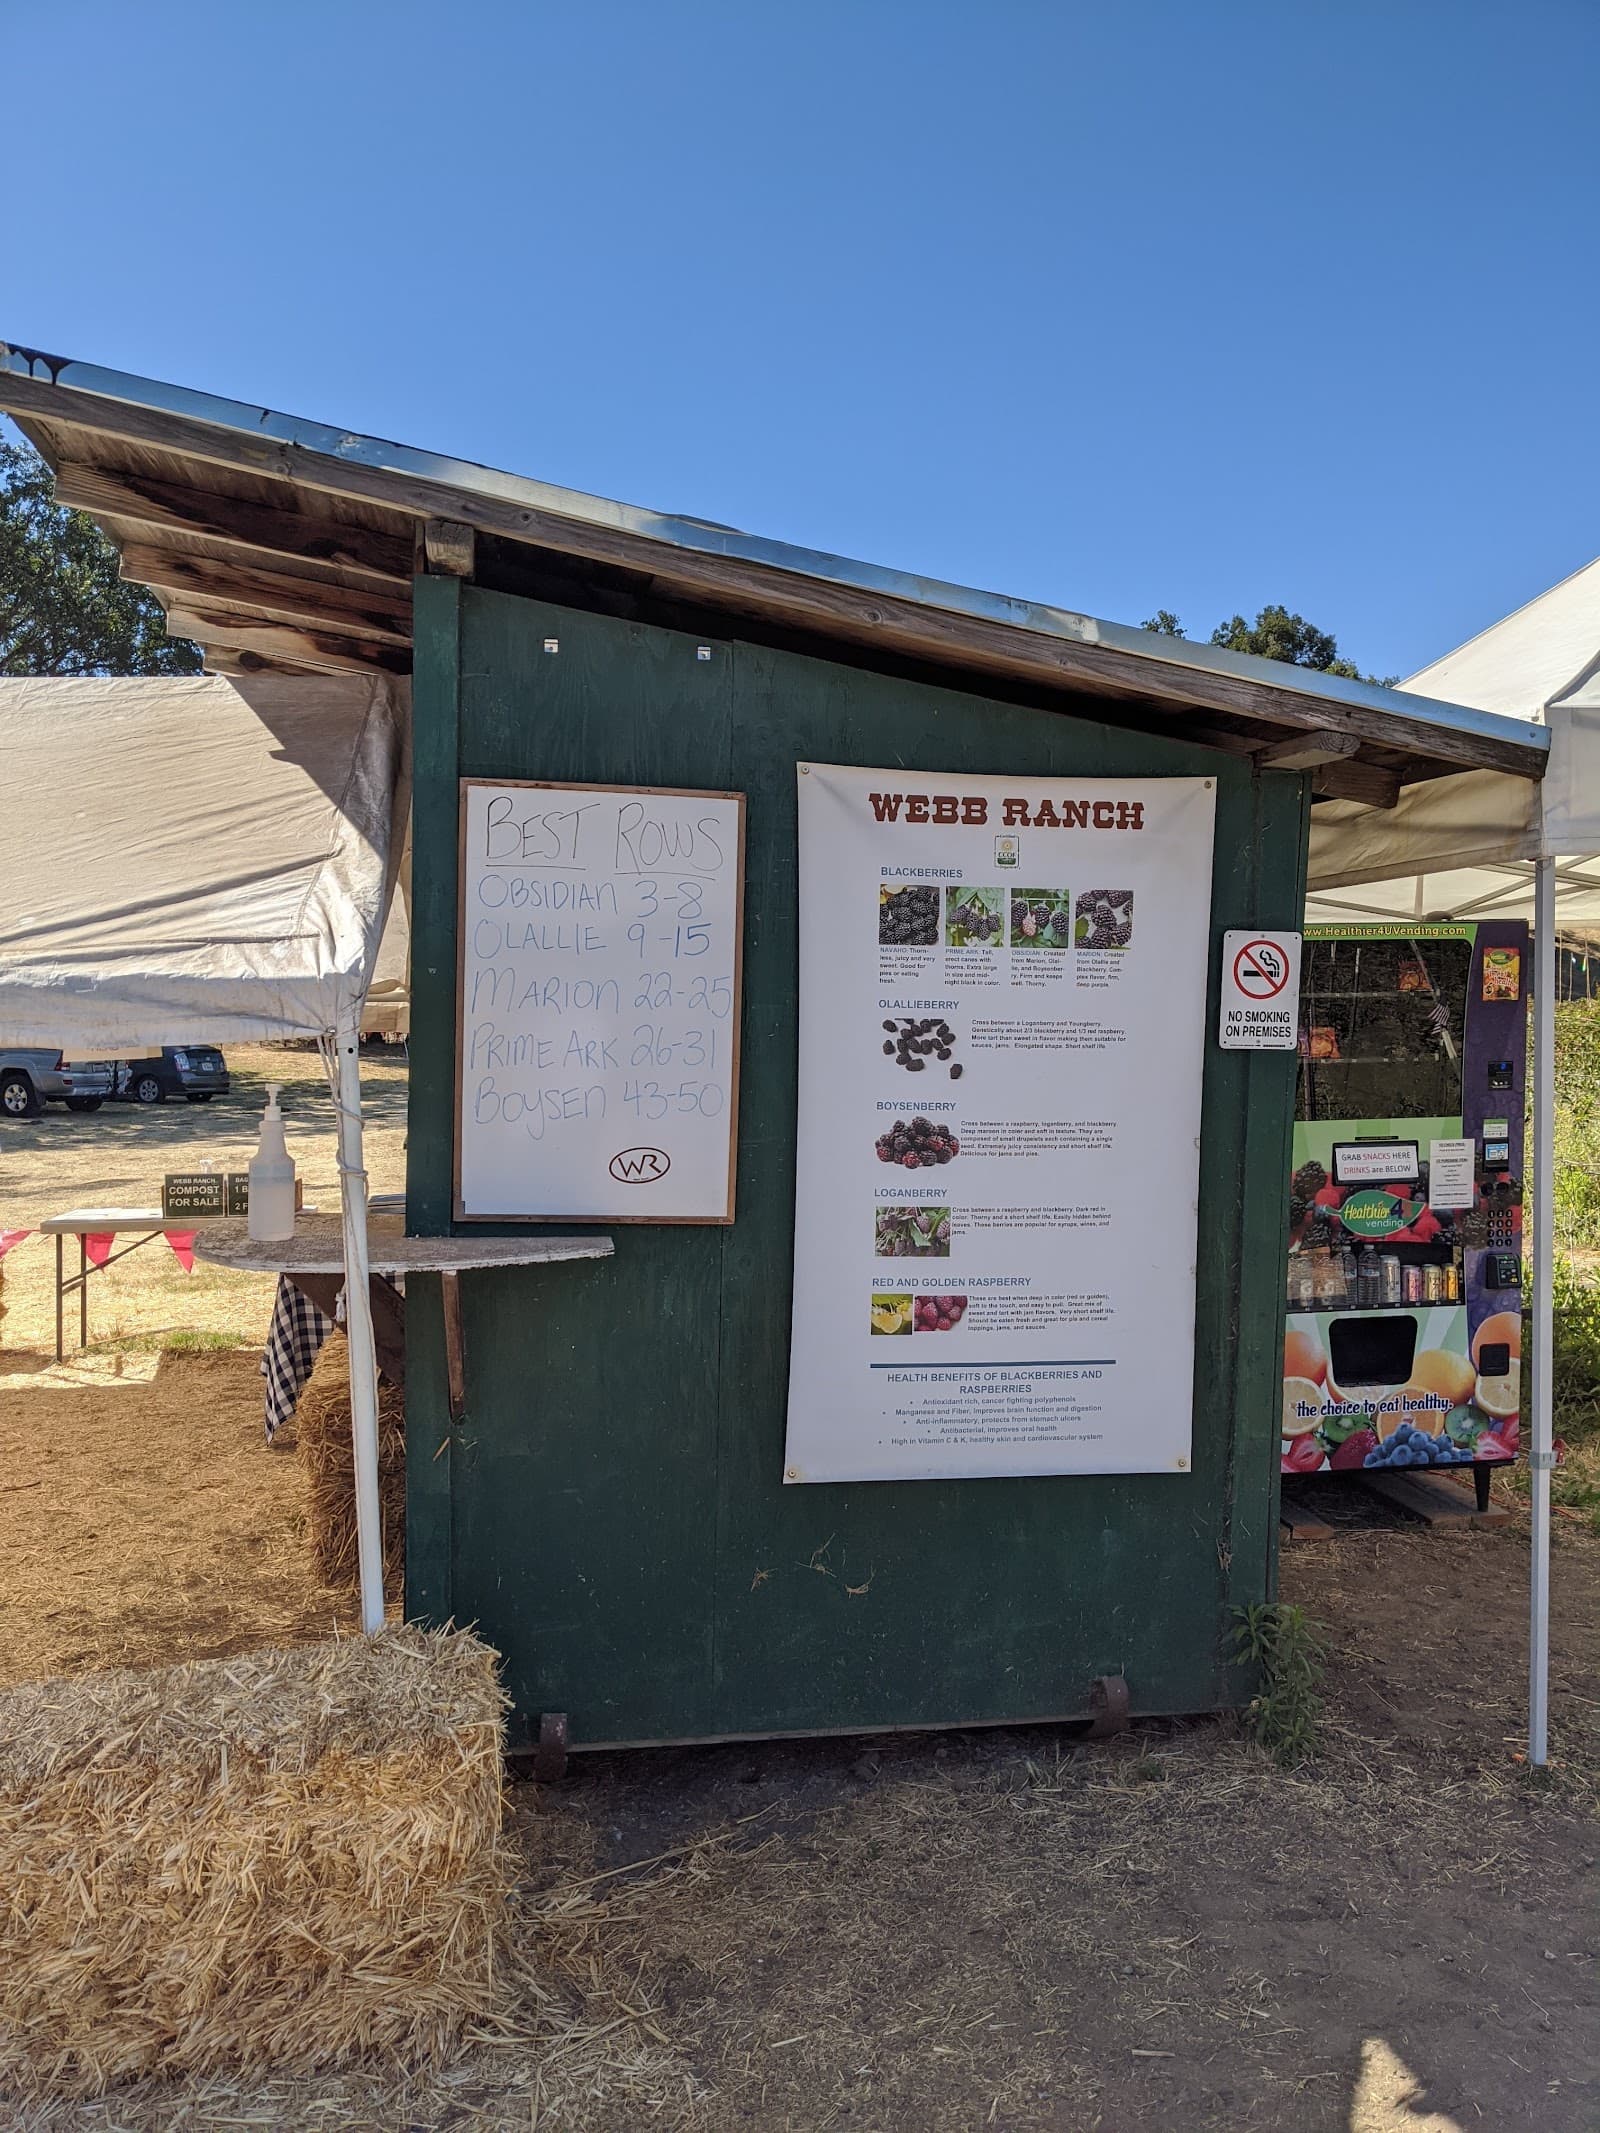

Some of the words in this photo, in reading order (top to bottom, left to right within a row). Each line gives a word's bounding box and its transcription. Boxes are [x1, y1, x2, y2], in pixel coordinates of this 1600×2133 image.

[869, 793, 988, 825] WEBB
[1002, 798, 1145, 829] RANCH
[486, 796, 600, 859] BEST
[615, 803, 724, 875] ROWS
[881, 867, 963, 879] BLACKBERRIES
[478, 875, 618, 914] OBSIDIAN
[635, 880, 703, 919] 3-8
[474, 919, 607, 959] OLALLIE
[472, 967, 619, 1014] MARION
[633, 972, 731, 1018] 22-25
[878, 999, 959, 1009] OLALLIEBERRY
[1228, 1011, 1242, 1021] NO
[1245, 1011, 1290, 1022] SMOKING
[1226, 1025, 1240, 1037] ON
[1243, 1026, 1291, 1037] PREMISES
[470, 1022, 555, 1071] PRIME
[563, 1035, 619, 1070] ARK
[631, 1025, 717, 1068] 26-31
[623, 1080, 724, 1119] 43-50
[876, 1101, 956, 1111] BOYSENBERRY
[1341, 1153, 1361, 1161] GRAB
[1363, 1152, 1391, 1160] SNACKS
[1393, 1151, 1411, 1159] HERE
[1344, 1166, 1370, 1174] DRINKS
[1385, 1165, 1411, 1173] BELOW
[168, 1185, 220, 1195] COMPOST
[874, 1188, 947, 1197] LOGANBERRY
[169, 1198, 190, 1207] FOR
[192, 1198, 220, 1206] SALE
[1344, 1201, 1390, 1220] Healthier
[1365, 1219, 1404, 1228] vending
[872, 1278, 893, 1286] RED
[896, 1278, 918, 1286] AND
[921, 1278, 965, 1286] GOLDEN
[968, 1277, 1031, 1286] RASPBERRY
[887, 1373, 927, 1382] HEALTH
[931, 1372, 980, 1382] BENEFITS
[983, 1372, 997, 1380] OF
[1000, 1370, 1078, 1380] BLACKBERRIES
[1081, 1370, 1102, 1378] AND
[959, 1384, 1031, 1393] RASPBERRIES
[1006, 1396, 1032, 1405] fighting
[1034, 1395, 1076, 1405] polyphenols
[1296, 1400, 1317, 1416] the
[1320, 1401, 1360, 1416] choice
[1363, 1400, 1376, 1413] to
[1379, 1398, 1399, 1412] eat
[1029, 1415, 1058, 1423] stomach
[1060, 1415, 1081, 1423] ulcers
